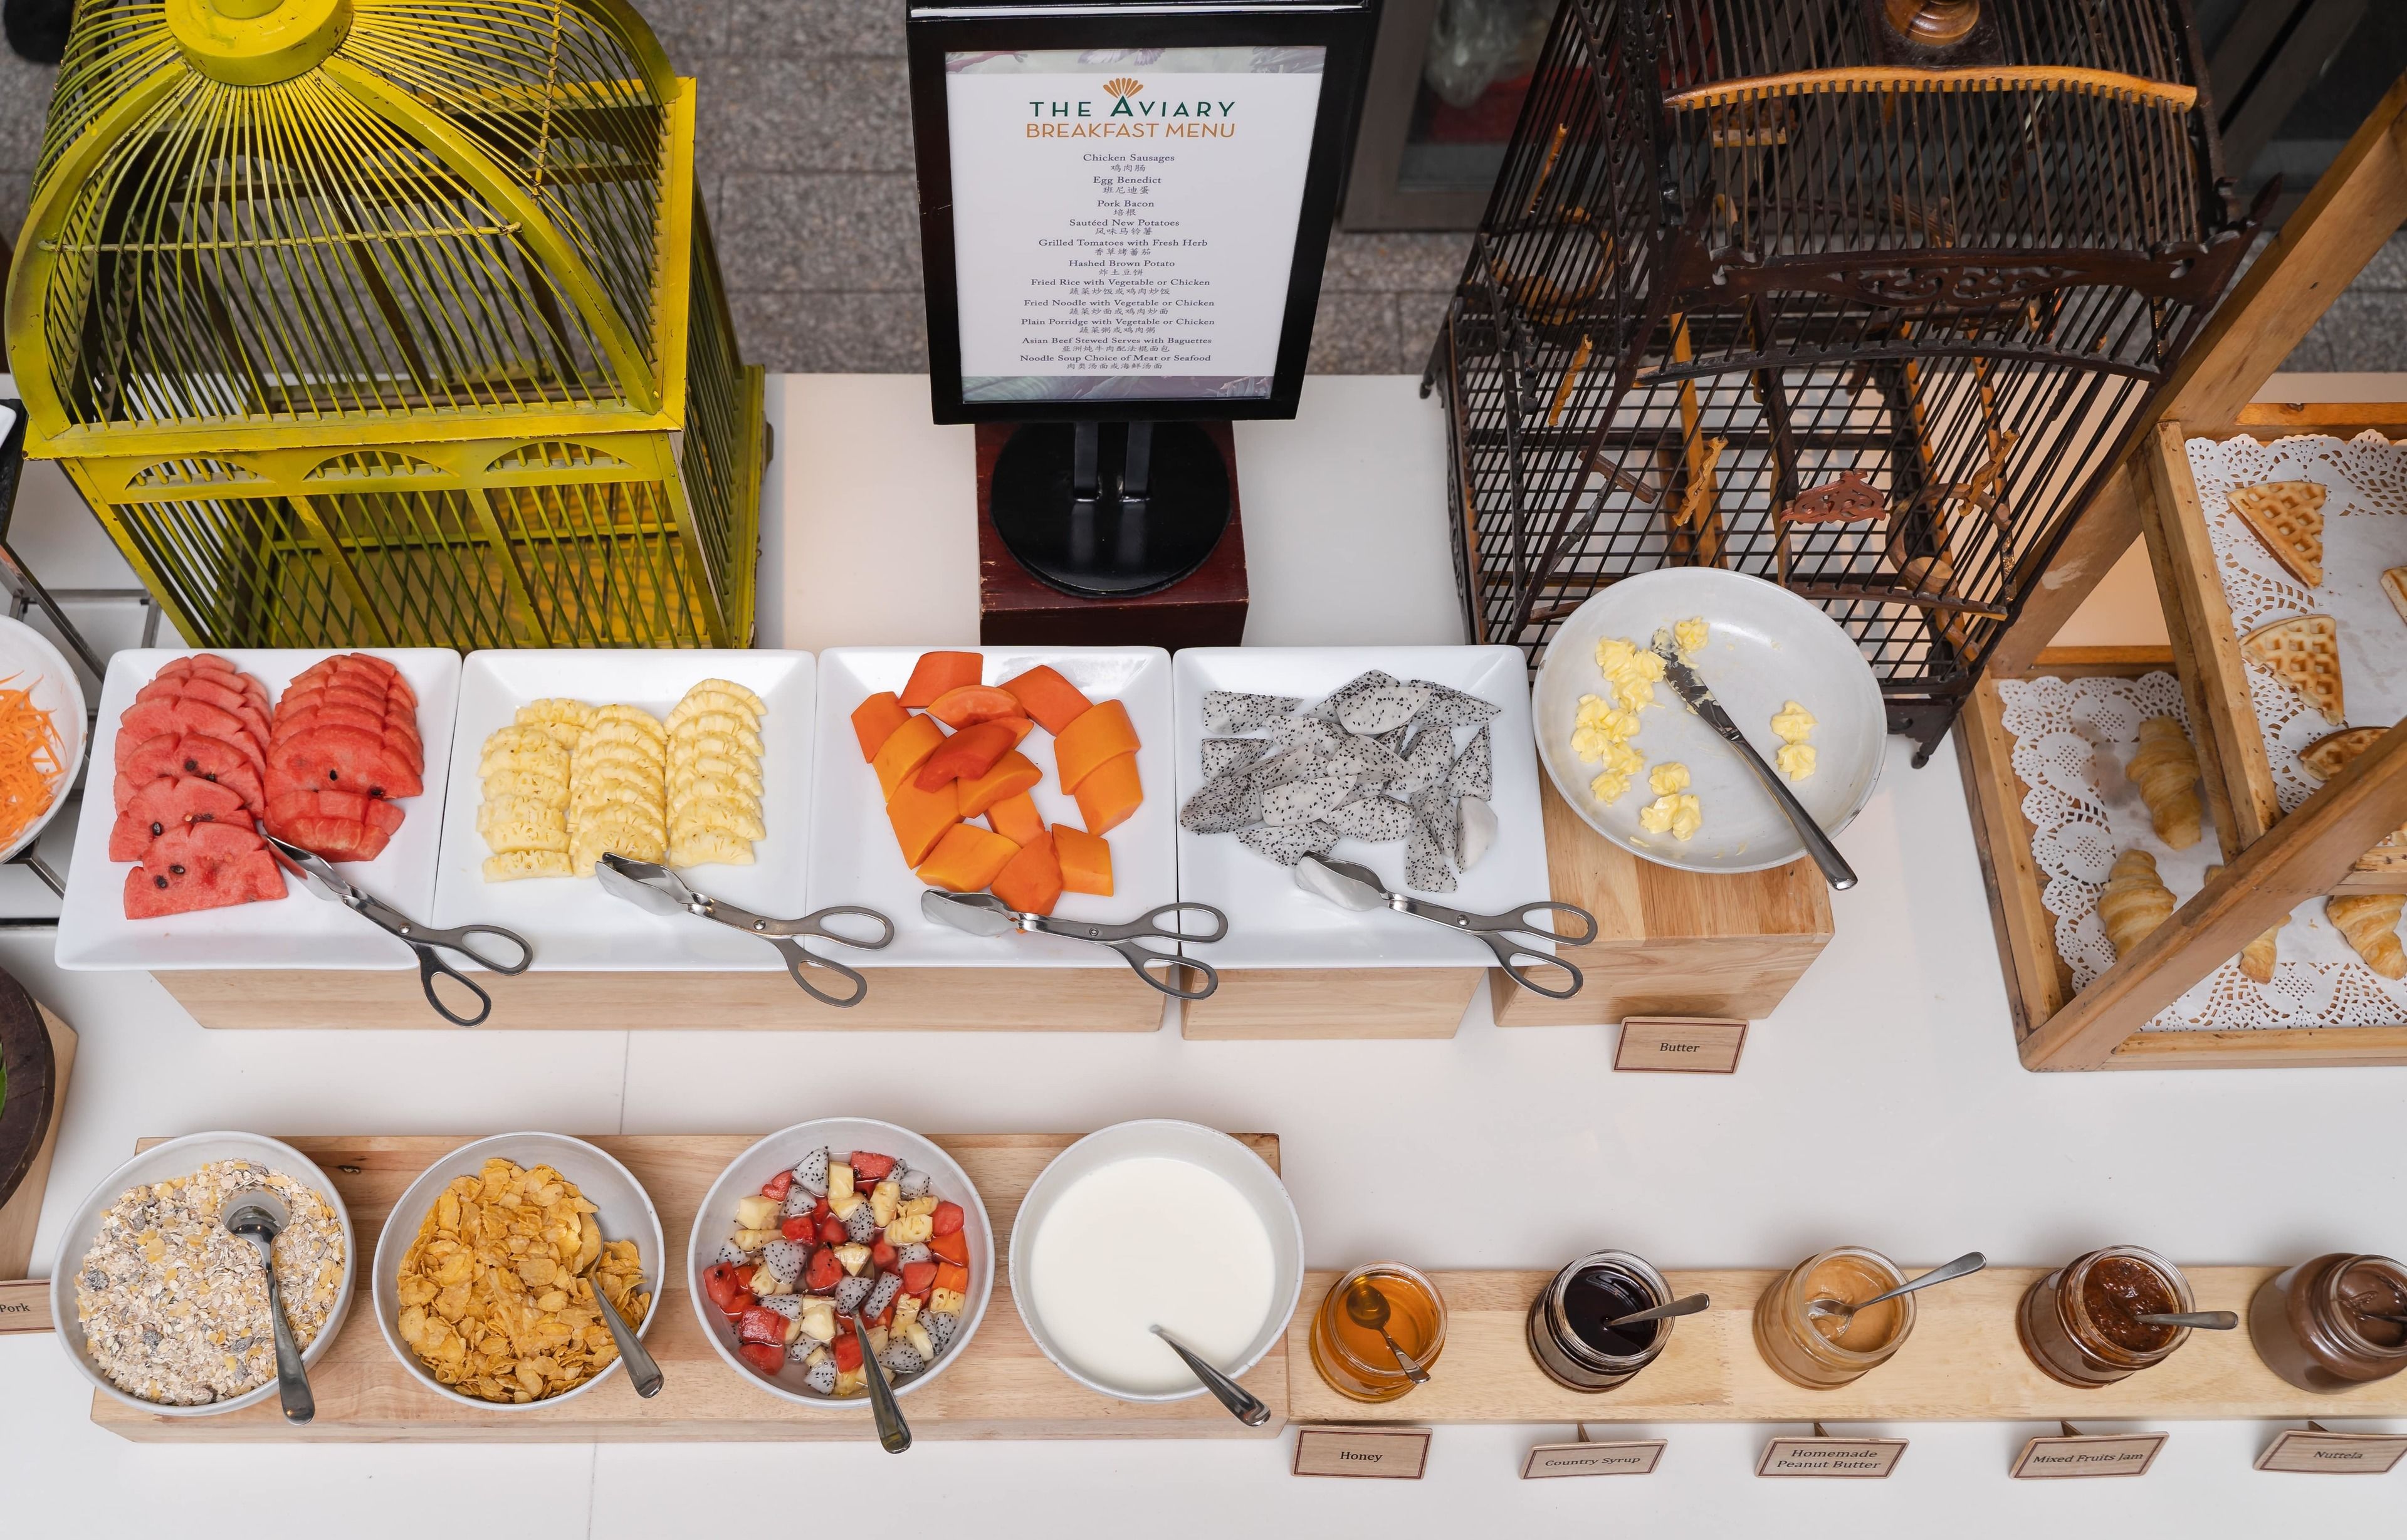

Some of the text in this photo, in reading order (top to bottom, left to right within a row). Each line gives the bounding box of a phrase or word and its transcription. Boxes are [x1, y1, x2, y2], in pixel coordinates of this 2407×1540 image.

[1029, 93, 1235, 117] THE AVIARY
[1027, 123, 1235, 138] BREAKFAST MENU
[1083, 154, 1175, 164] Chicken Sausages
[1093, 176, 1114, 186] Egg
[1108, 278, 1154, 288] Vegetable
[1114, 299, 1159, 308] Vegetable
[1049, 318, 1088, 327] Porridge
[1115, 318, 1160, 327] Vegetable
[1167, 337, 1212, 345] Baguettes
[1057, 355, 1081, 364] Soup
[1659, 1042, 1701, 1052] Butter
[0, 1302, 31, 1312] Pork
[1340, 1451, 1383, 1463] Honey
[1791, 1449, 1878, 1458] Homemade
[2032, 1453, 2144, 1463] Mixed Fruits Jam
[2313, 1451, 2363, 1459] Nuttela
[1832, 1460, 1881, 1469] Butter
